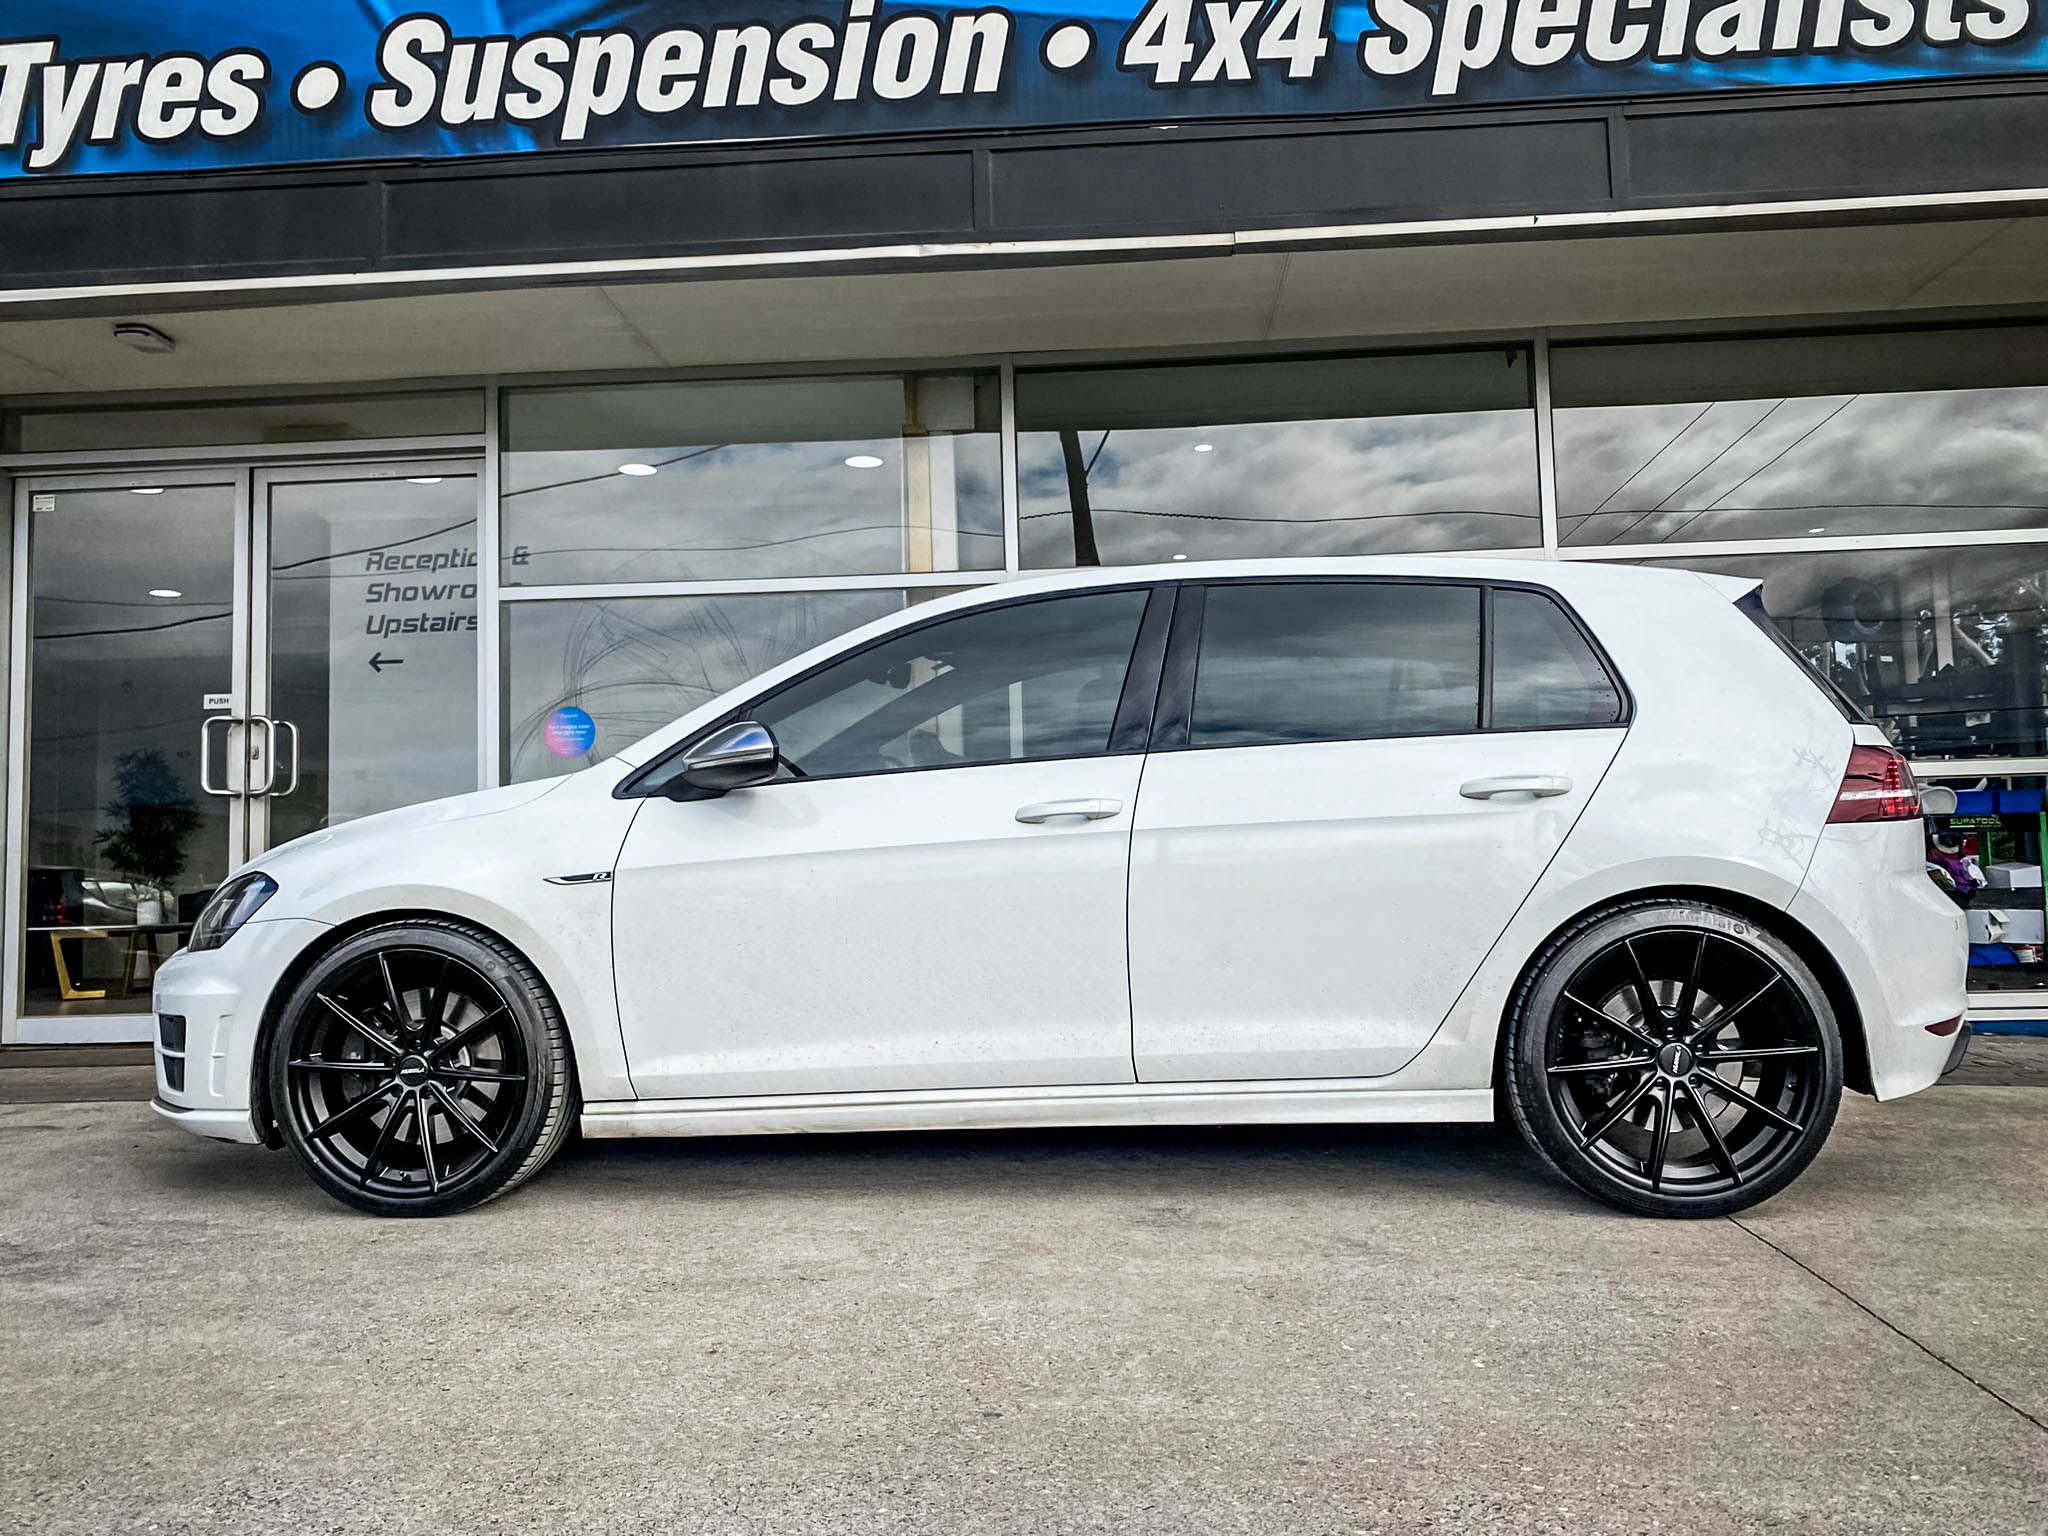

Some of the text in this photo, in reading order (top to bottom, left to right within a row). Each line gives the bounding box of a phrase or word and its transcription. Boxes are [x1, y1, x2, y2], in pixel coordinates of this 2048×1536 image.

[0, 42, 265, 168] Tyres
[371, 0, 1009, 141] Suspension
[1124, 0, 1328, 83] 4x4
[365, 548, 478, 573] Receptio
[365, 583, 478, 603] Showro
[365, 612, 478, 639] Upstairs
[208, 697, 230, 705] PUSH
